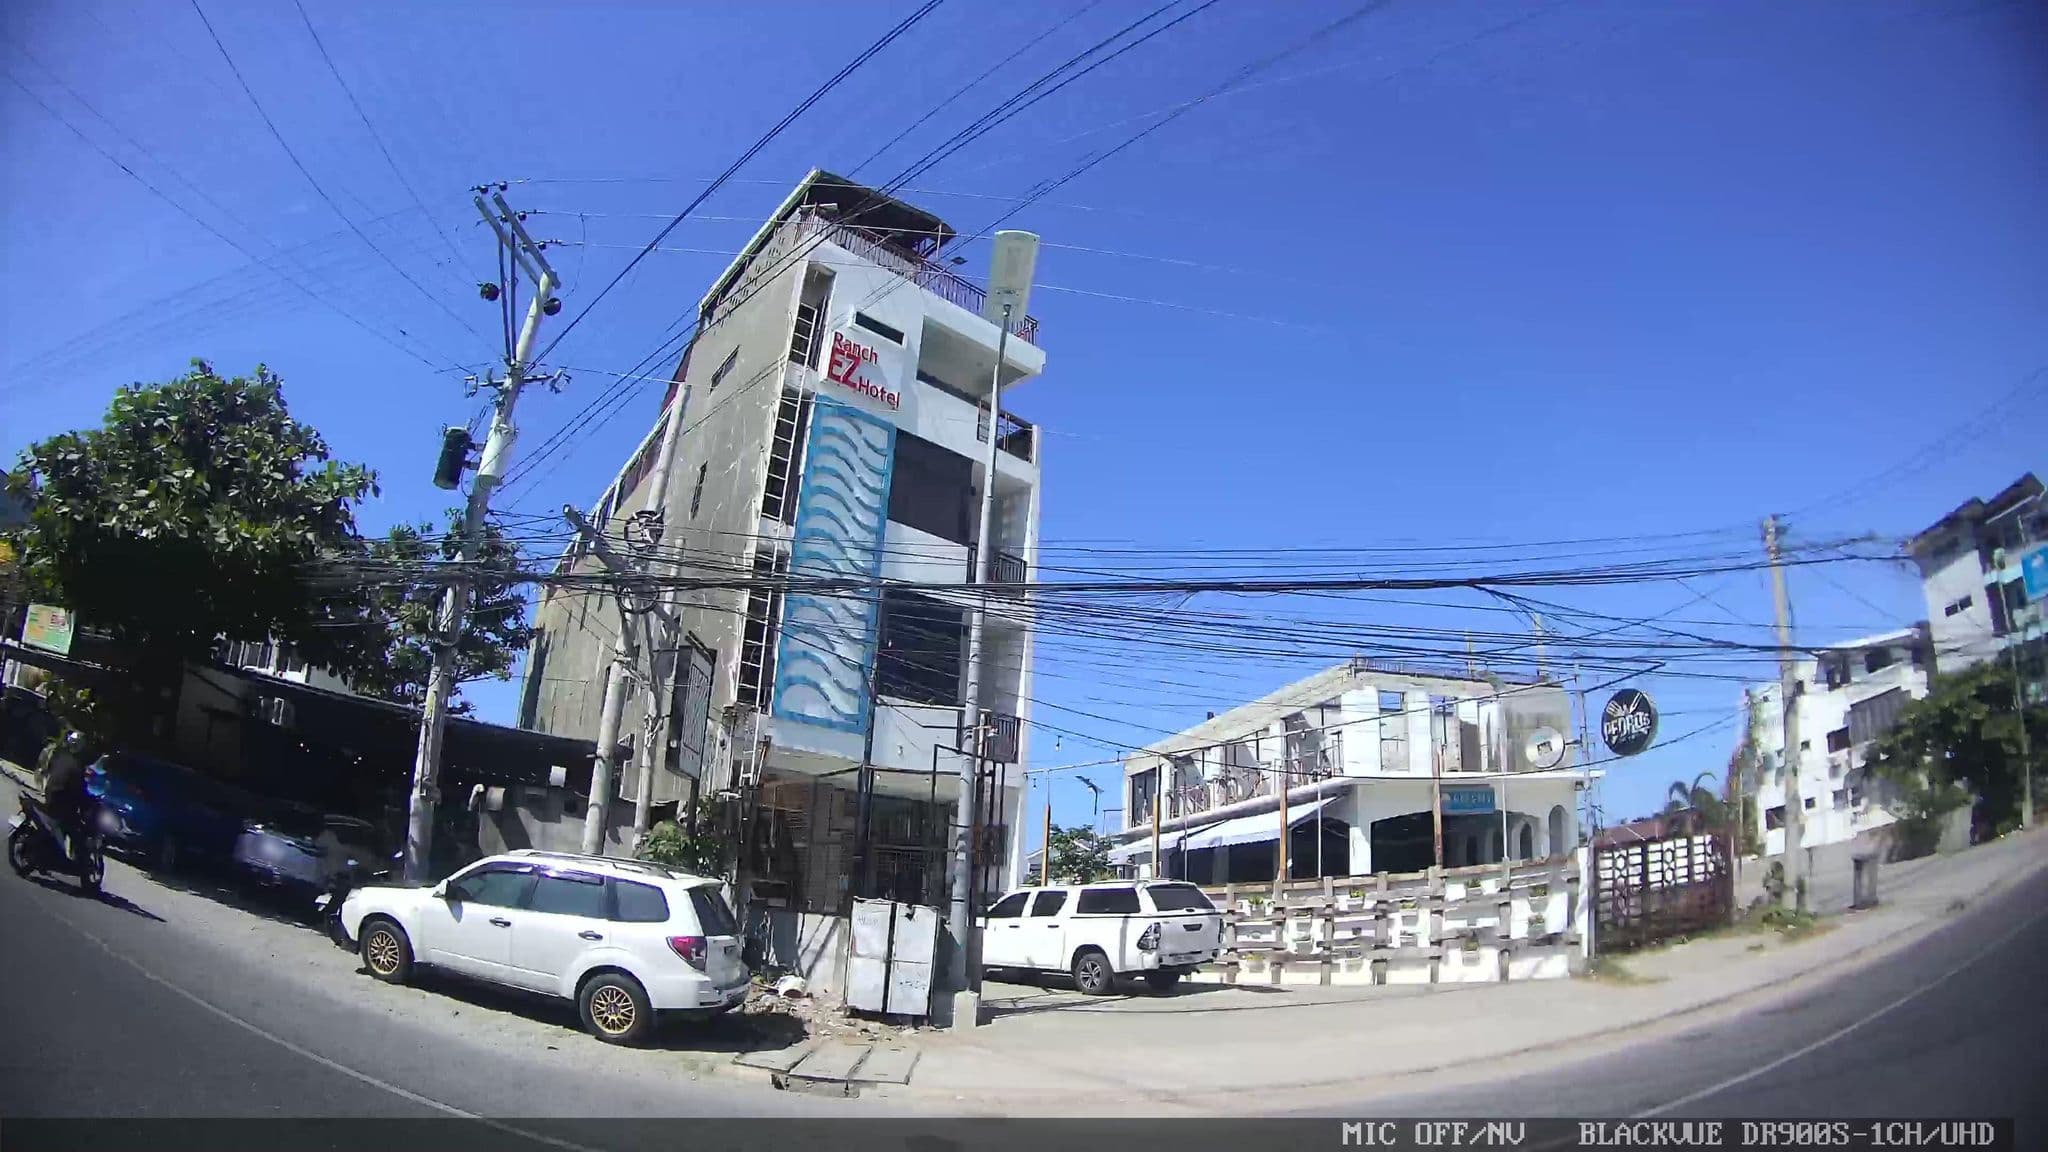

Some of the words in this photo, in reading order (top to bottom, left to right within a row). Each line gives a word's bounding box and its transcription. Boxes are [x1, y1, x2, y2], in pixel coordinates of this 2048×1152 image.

[834, 331, 878, 365] Ranch
[828, 347, 861, 389] EZ
[858, 375, 901, 409] Hotel
